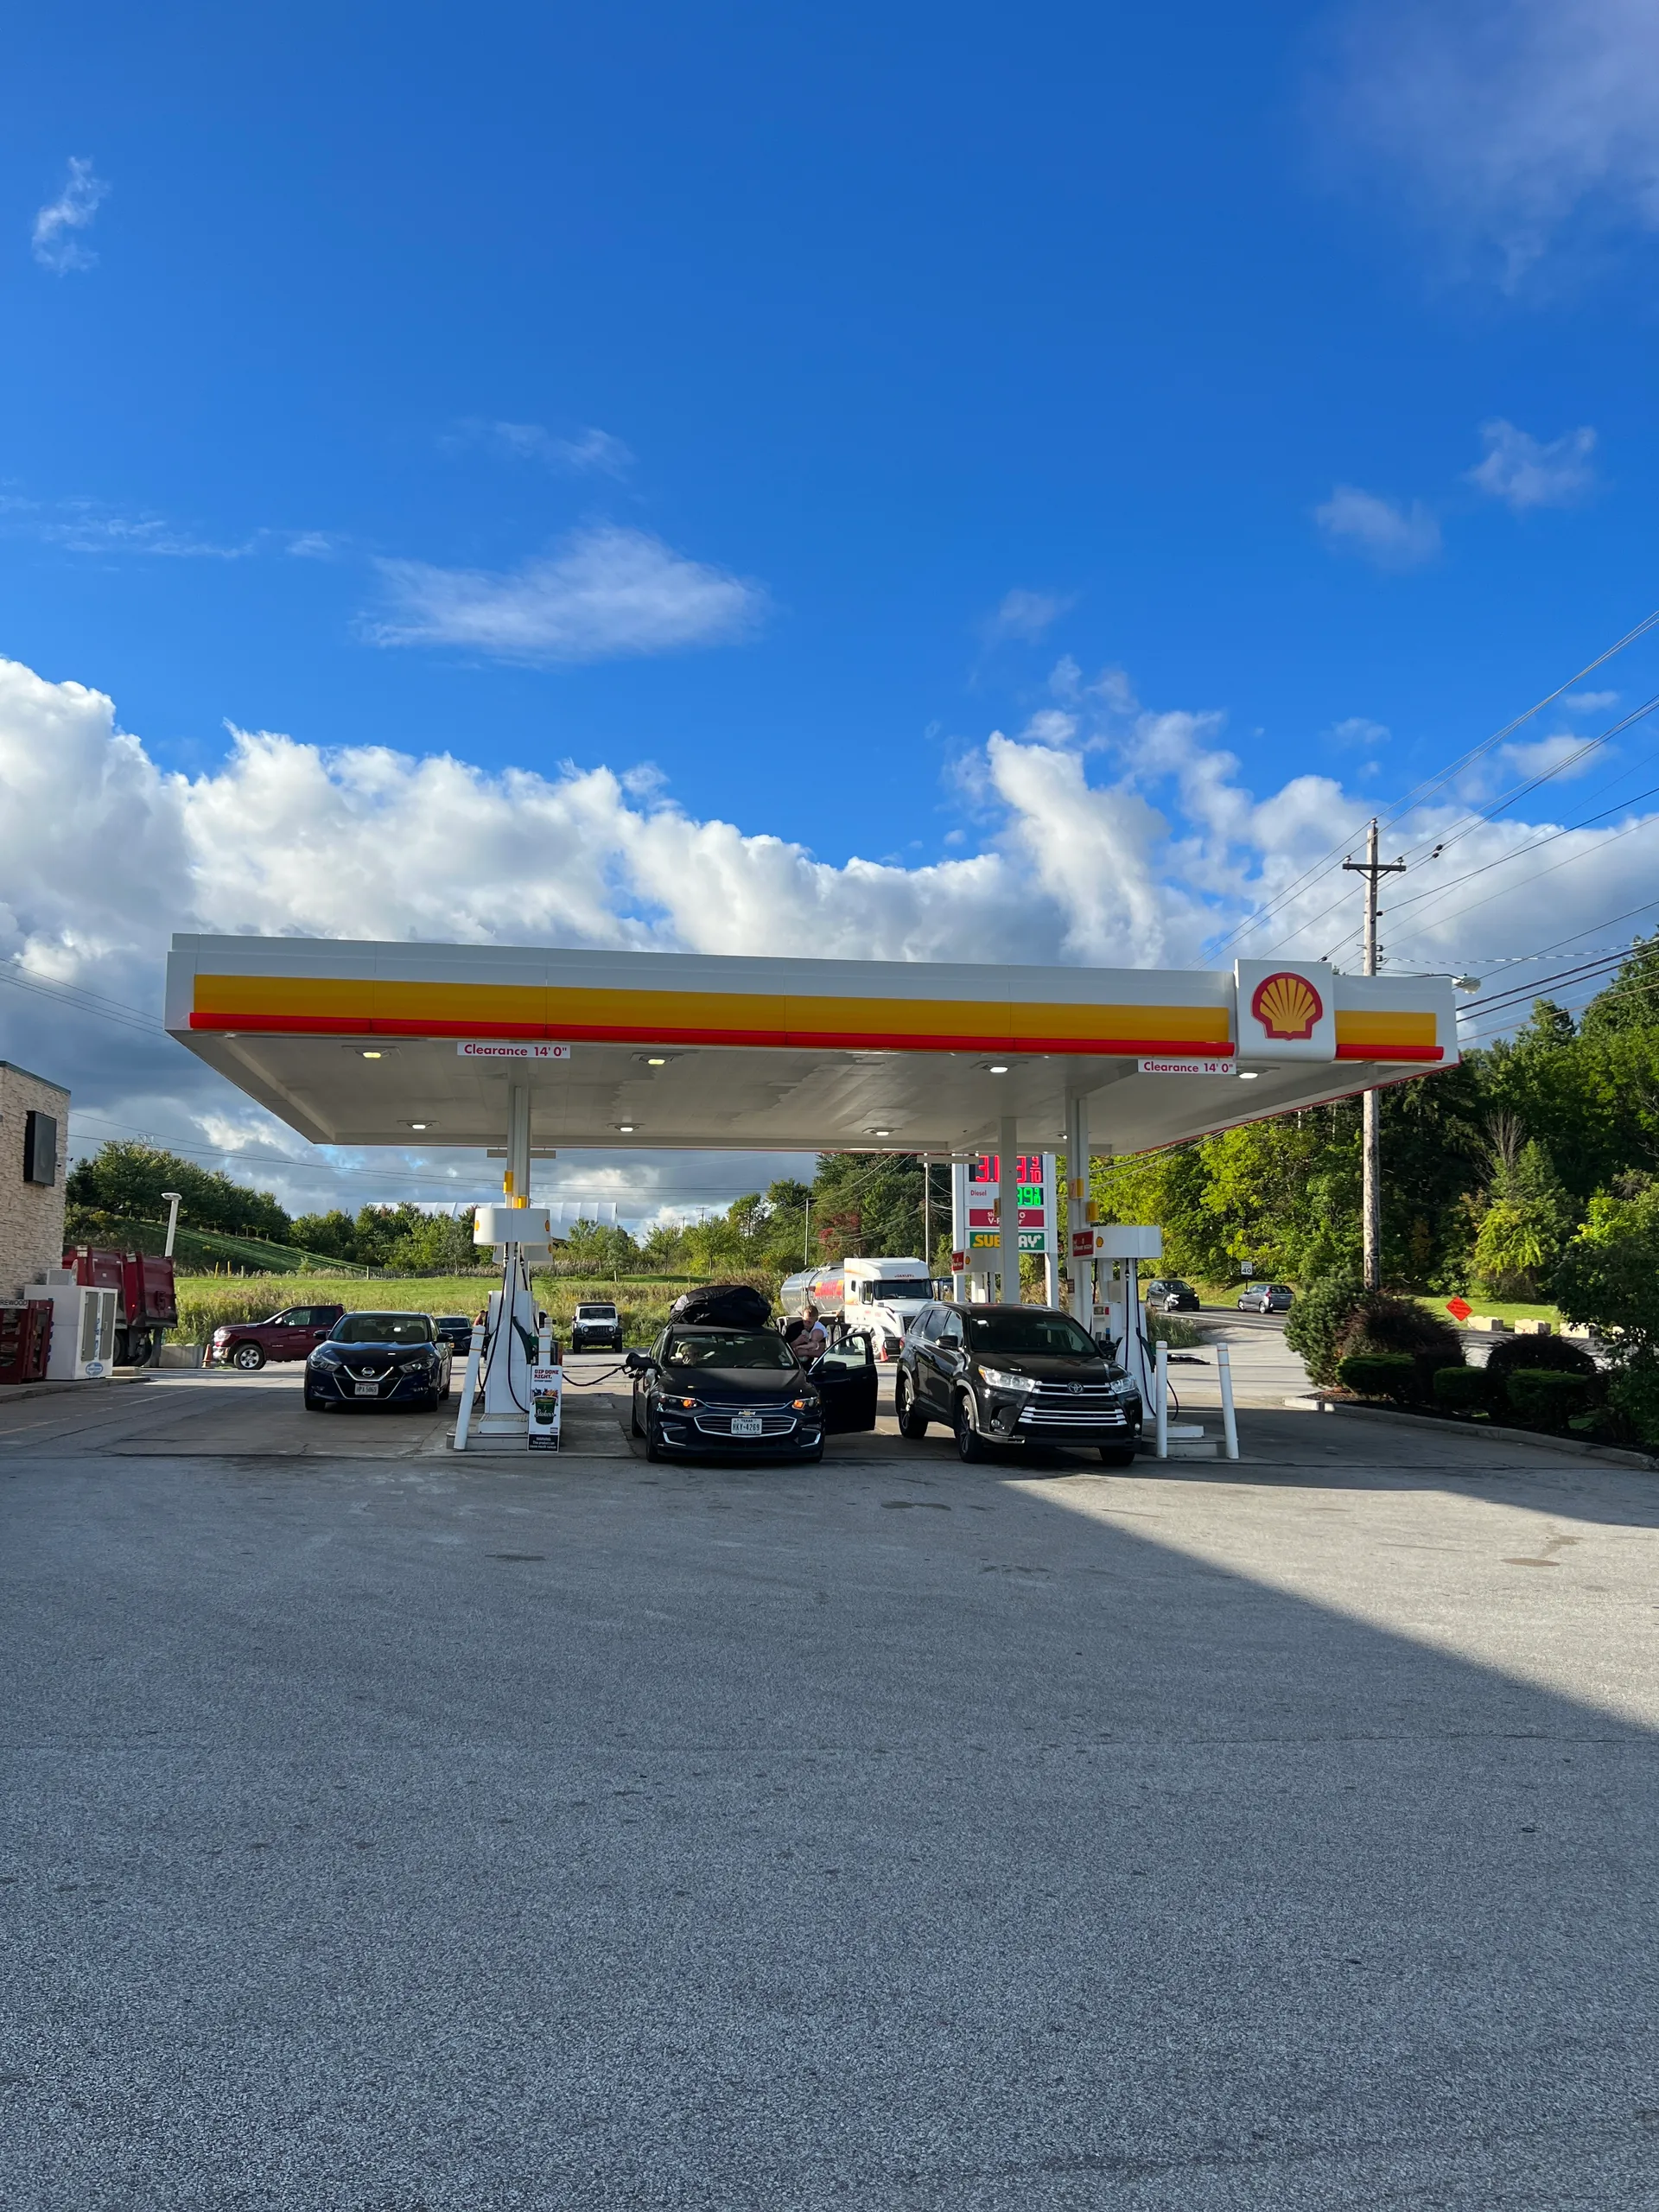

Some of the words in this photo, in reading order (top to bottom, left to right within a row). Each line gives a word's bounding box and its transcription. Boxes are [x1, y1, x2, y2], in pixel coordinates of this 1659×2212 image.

[464, 1044, 528, 1056] Clearance
[534, 1046, 551, 1056] 14'
[553, 1046, 567, 1057] 0"
[1144, 1061, 1198, 1072] Clearance
[1204, 1063, 1218, 1072] 14'
[1221, 1064, 1233, 1073] 0"
